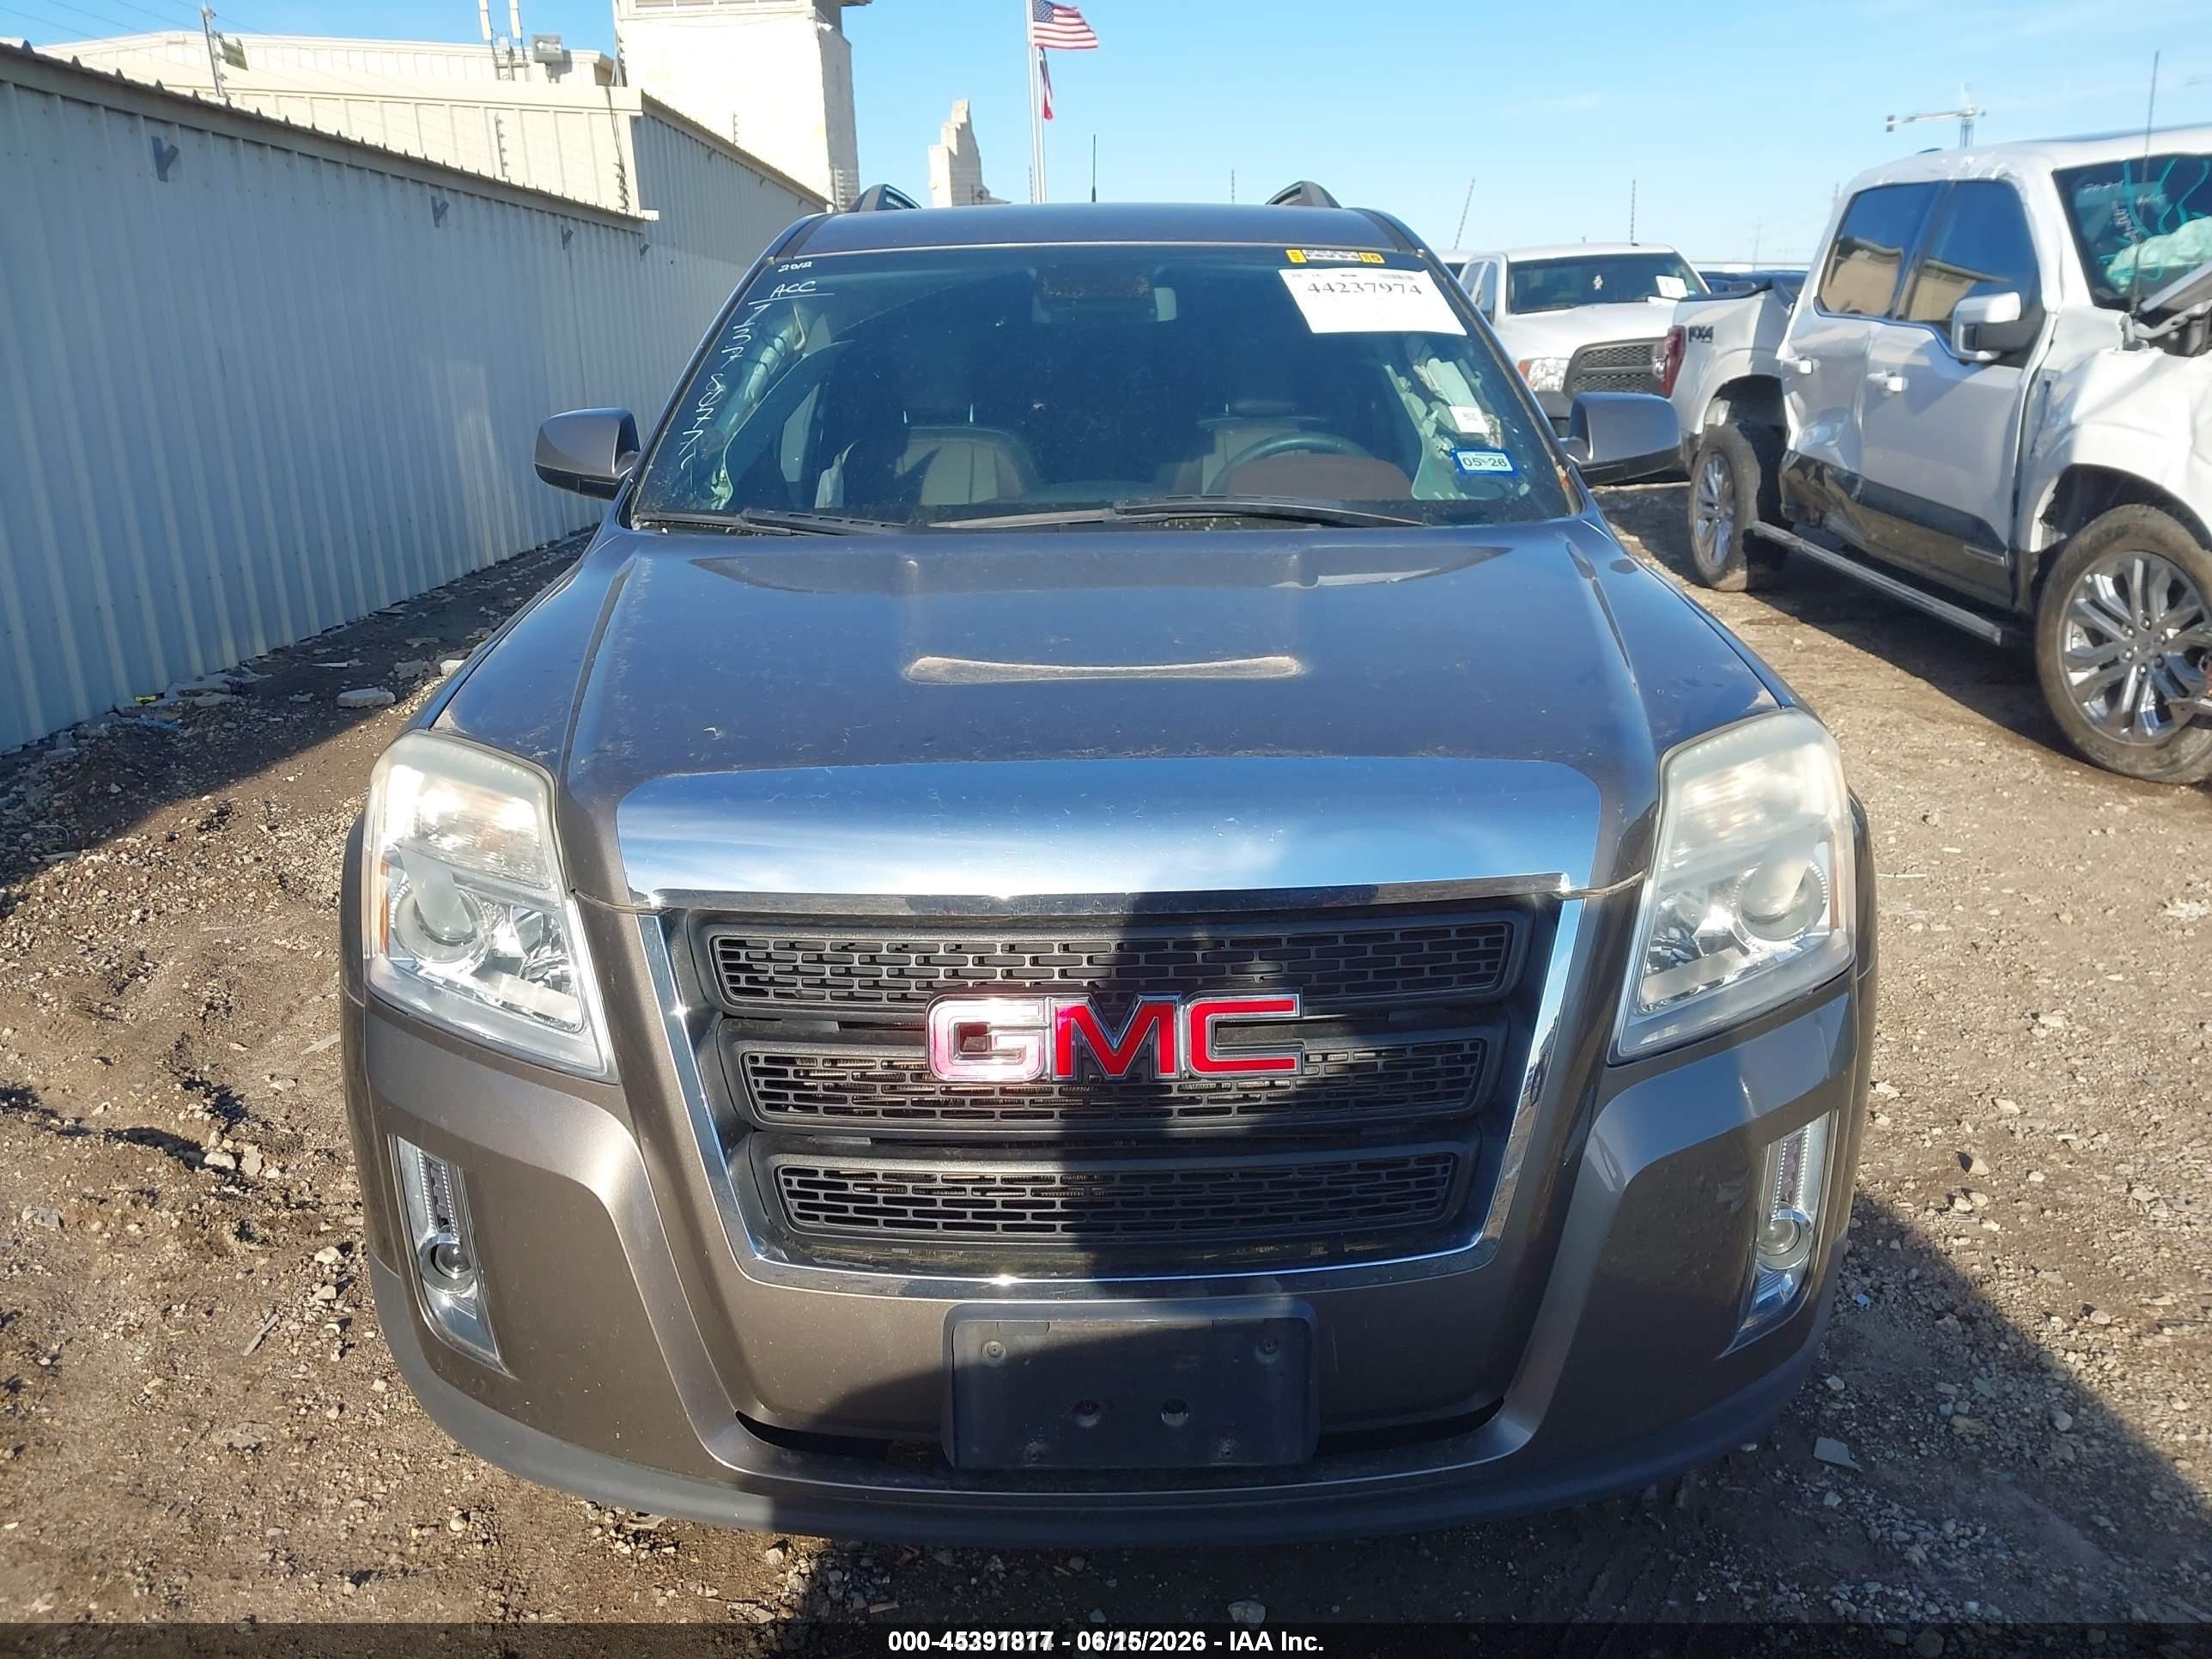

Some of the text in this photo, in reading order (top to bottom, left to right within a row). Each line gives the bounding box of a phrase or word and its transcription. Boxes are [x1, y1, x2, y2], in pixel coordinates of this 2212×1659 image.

[769, 280, 817, 298] ACC
[1307, 282, 1422, 295] 44237974
[926, 991, 1304, 1085] GMC
